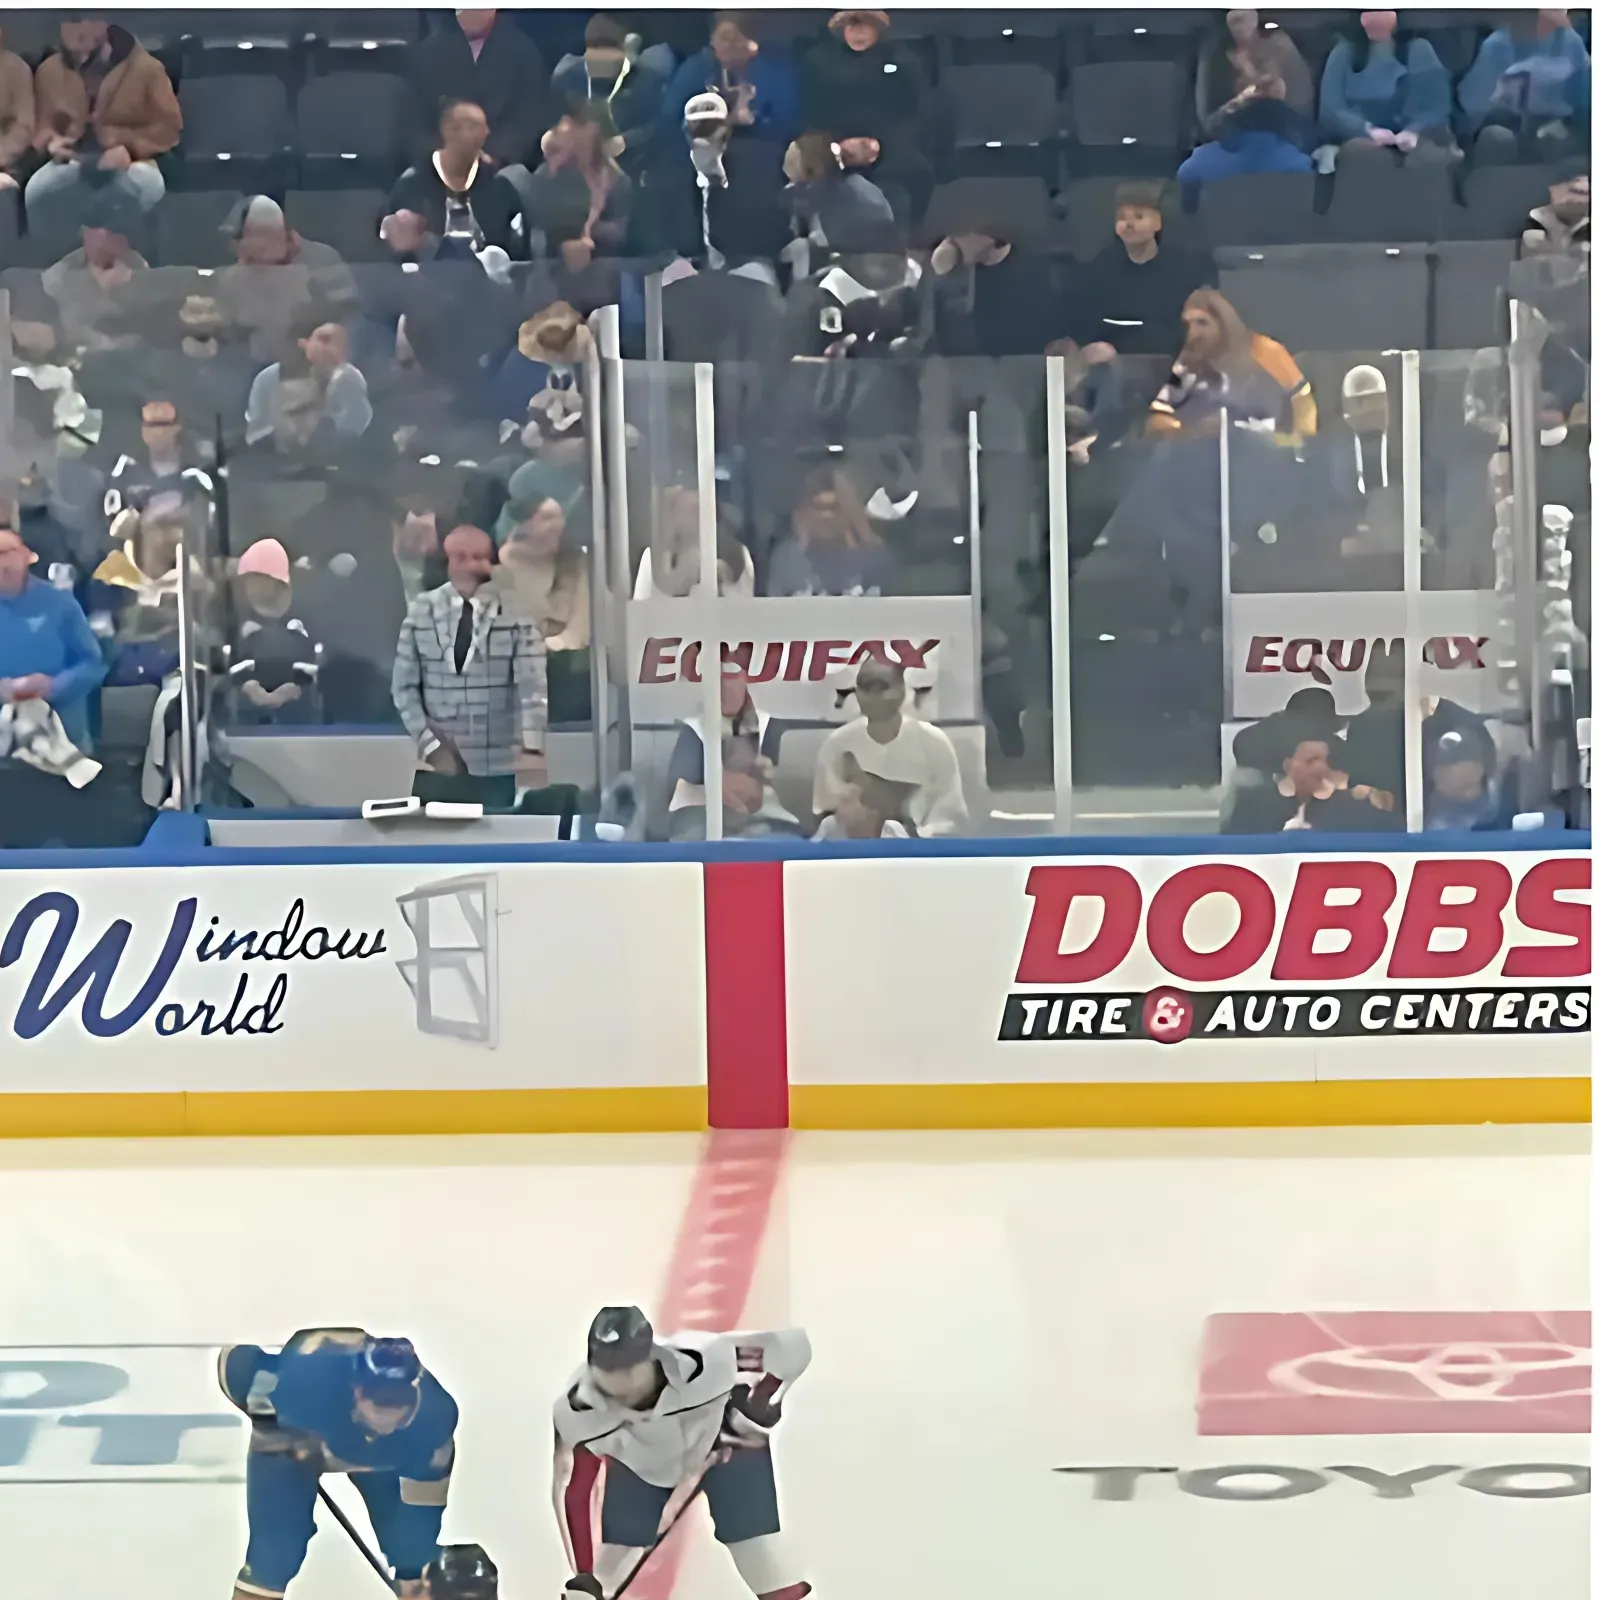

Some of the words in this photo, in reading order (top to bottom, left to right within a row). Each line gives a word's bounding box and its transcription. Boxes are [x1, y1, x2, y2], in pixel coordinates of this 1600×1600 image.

[1014, 858, 1591, 984] DOBBS
[1020, 998, 1130, 1035] TIRE
[1148, 996, 1186, 1033] &
[1204, 996, 1340, 1033] AUTO
[1359, 992, 1590, 1031] CENTERS
[1051, 1463, 1591, 1501] TOYO
